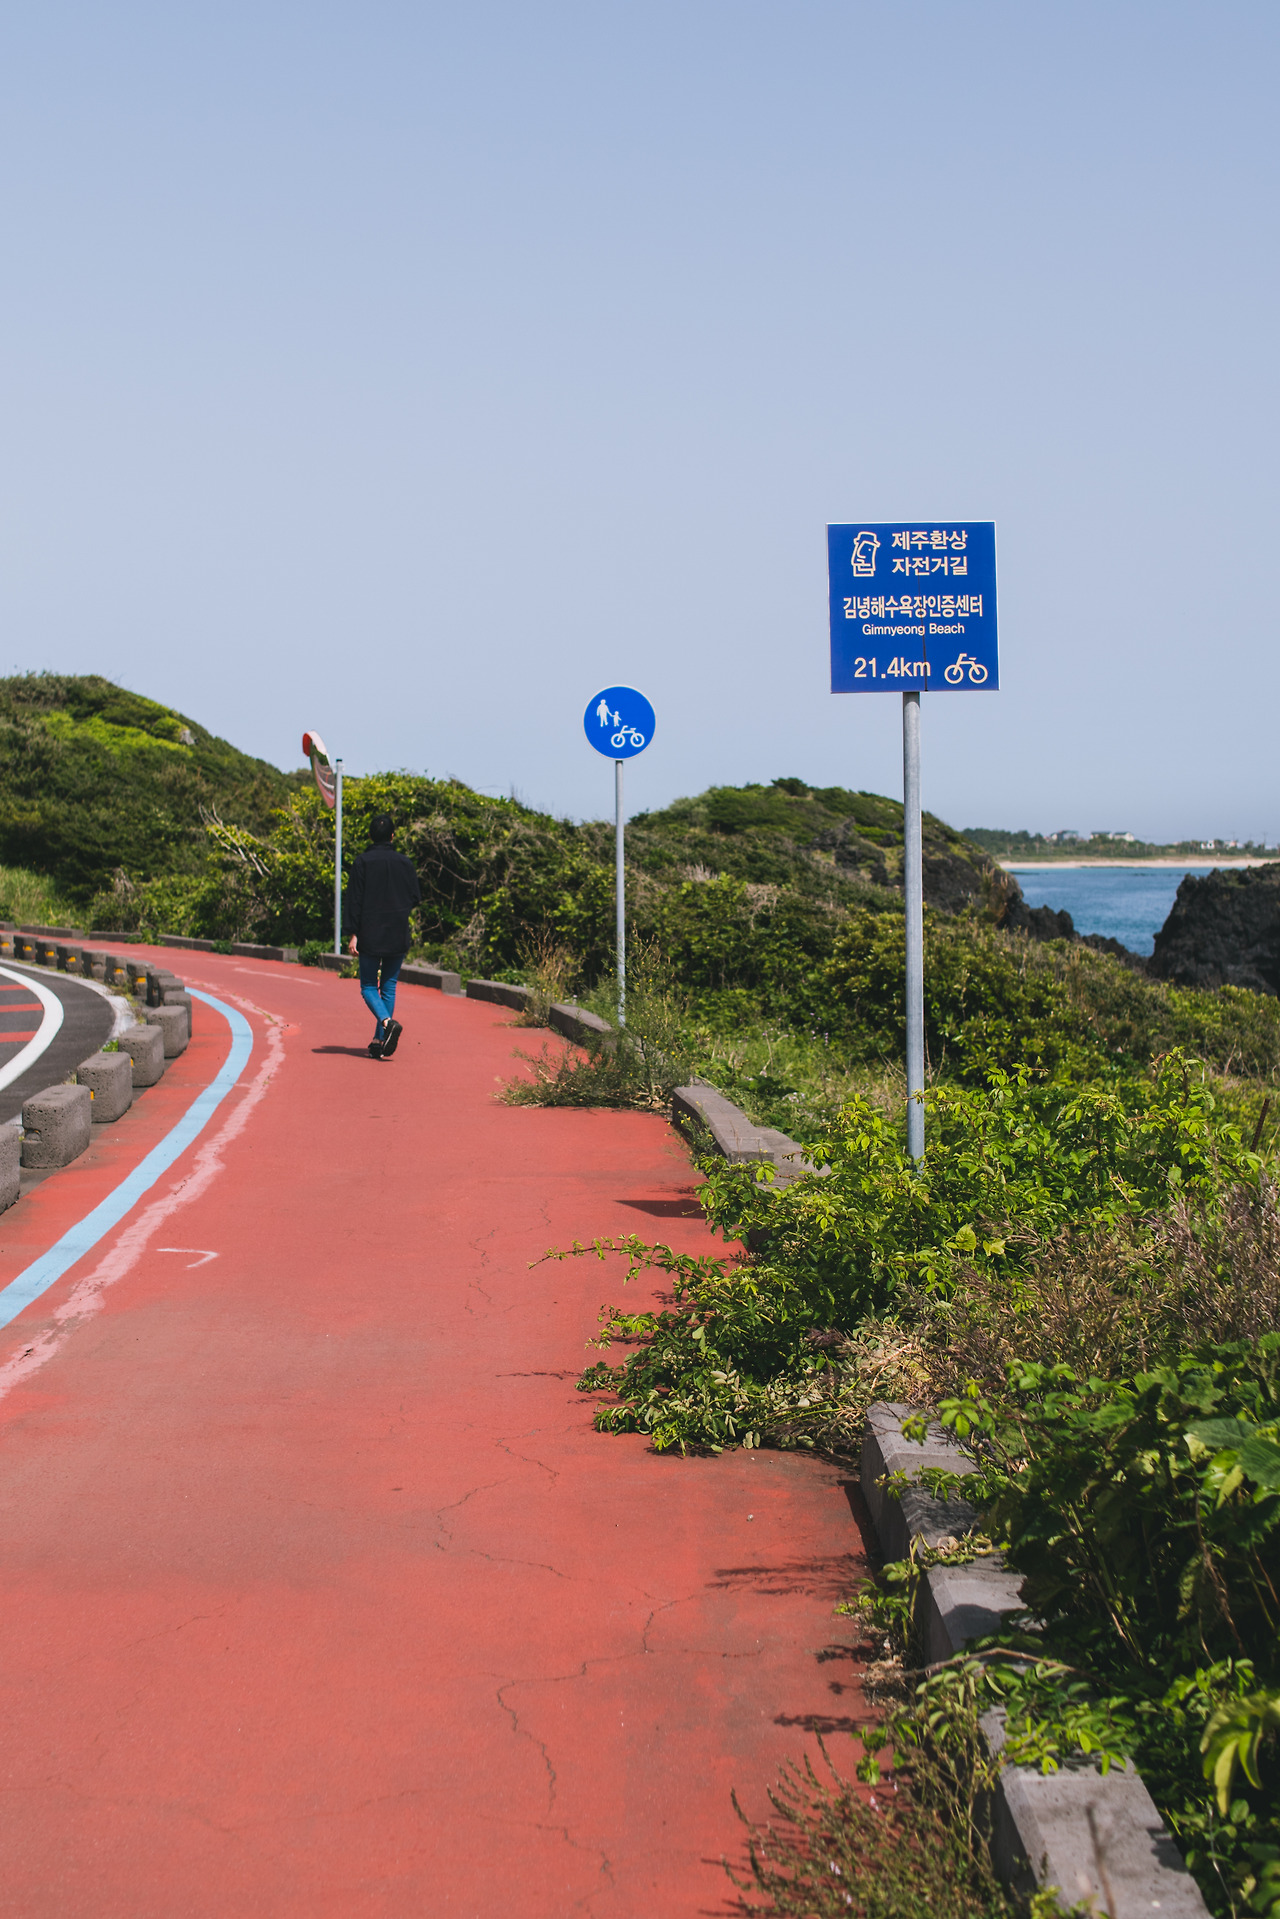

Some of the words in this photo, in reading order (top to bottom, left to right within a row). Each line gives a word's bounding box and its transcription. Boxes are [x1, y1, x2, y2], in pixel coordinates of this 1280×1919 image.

[891, 530, 968, 551] 제주환상
[891, 556, 968, 576] 자전거길
[843, 594, 983, 619] 김녕해수욕장인증센터
[862, 624, 925, 636] Gimnyeong
[929, 623, 965, 634] Beach
[854, 657, 931, 679] 21.4km
